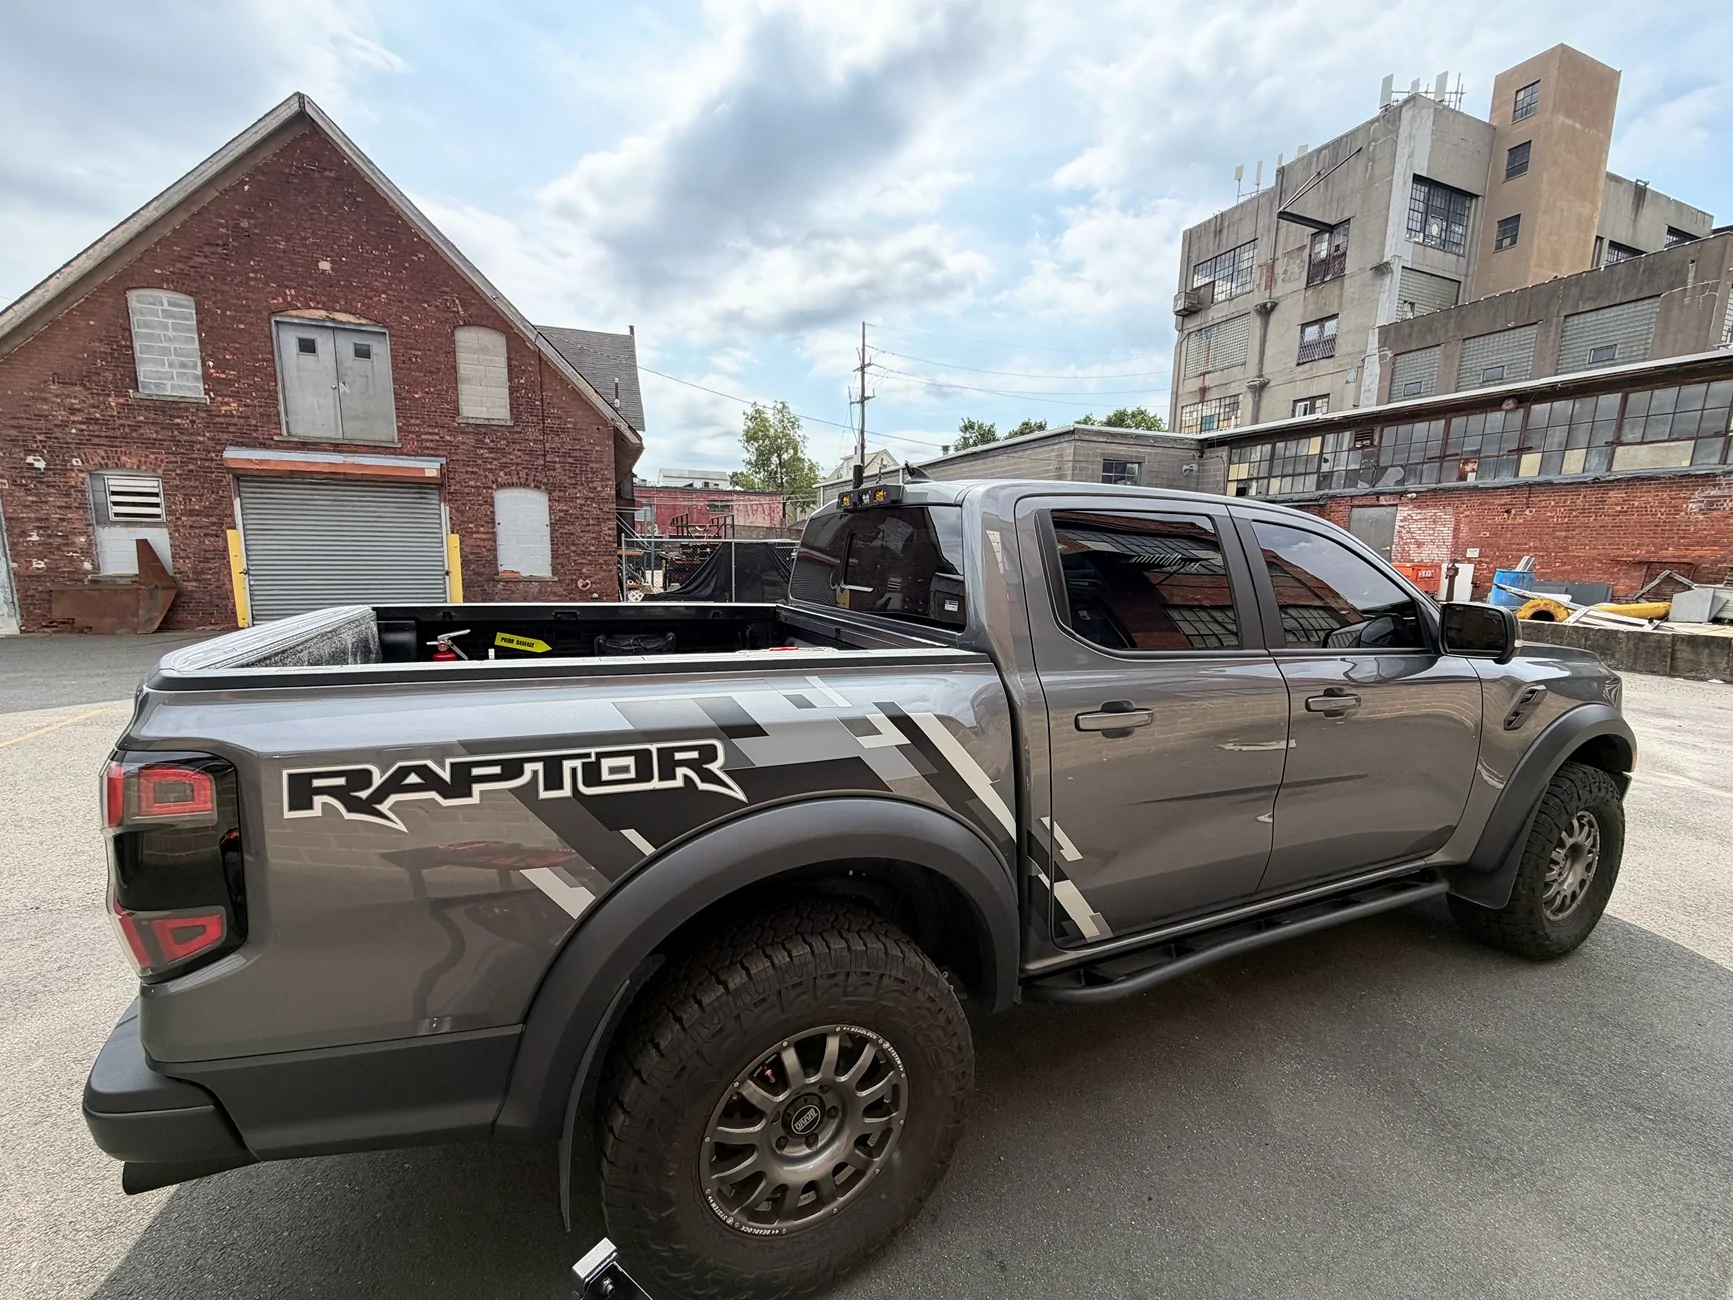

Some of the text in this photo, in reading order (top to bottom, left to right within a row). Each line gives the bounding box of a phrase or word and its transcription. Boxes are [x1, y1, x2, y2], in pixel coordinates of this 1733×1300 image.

[516, 640, 535, 648] DAMAGE
[282, 738, 749, 833] RAPTOR
[850, 1027, 902, 1065] BEADLOCK SYSTEM
[711, 1202, 771, 1235] BEADLOCK SYSTEM
